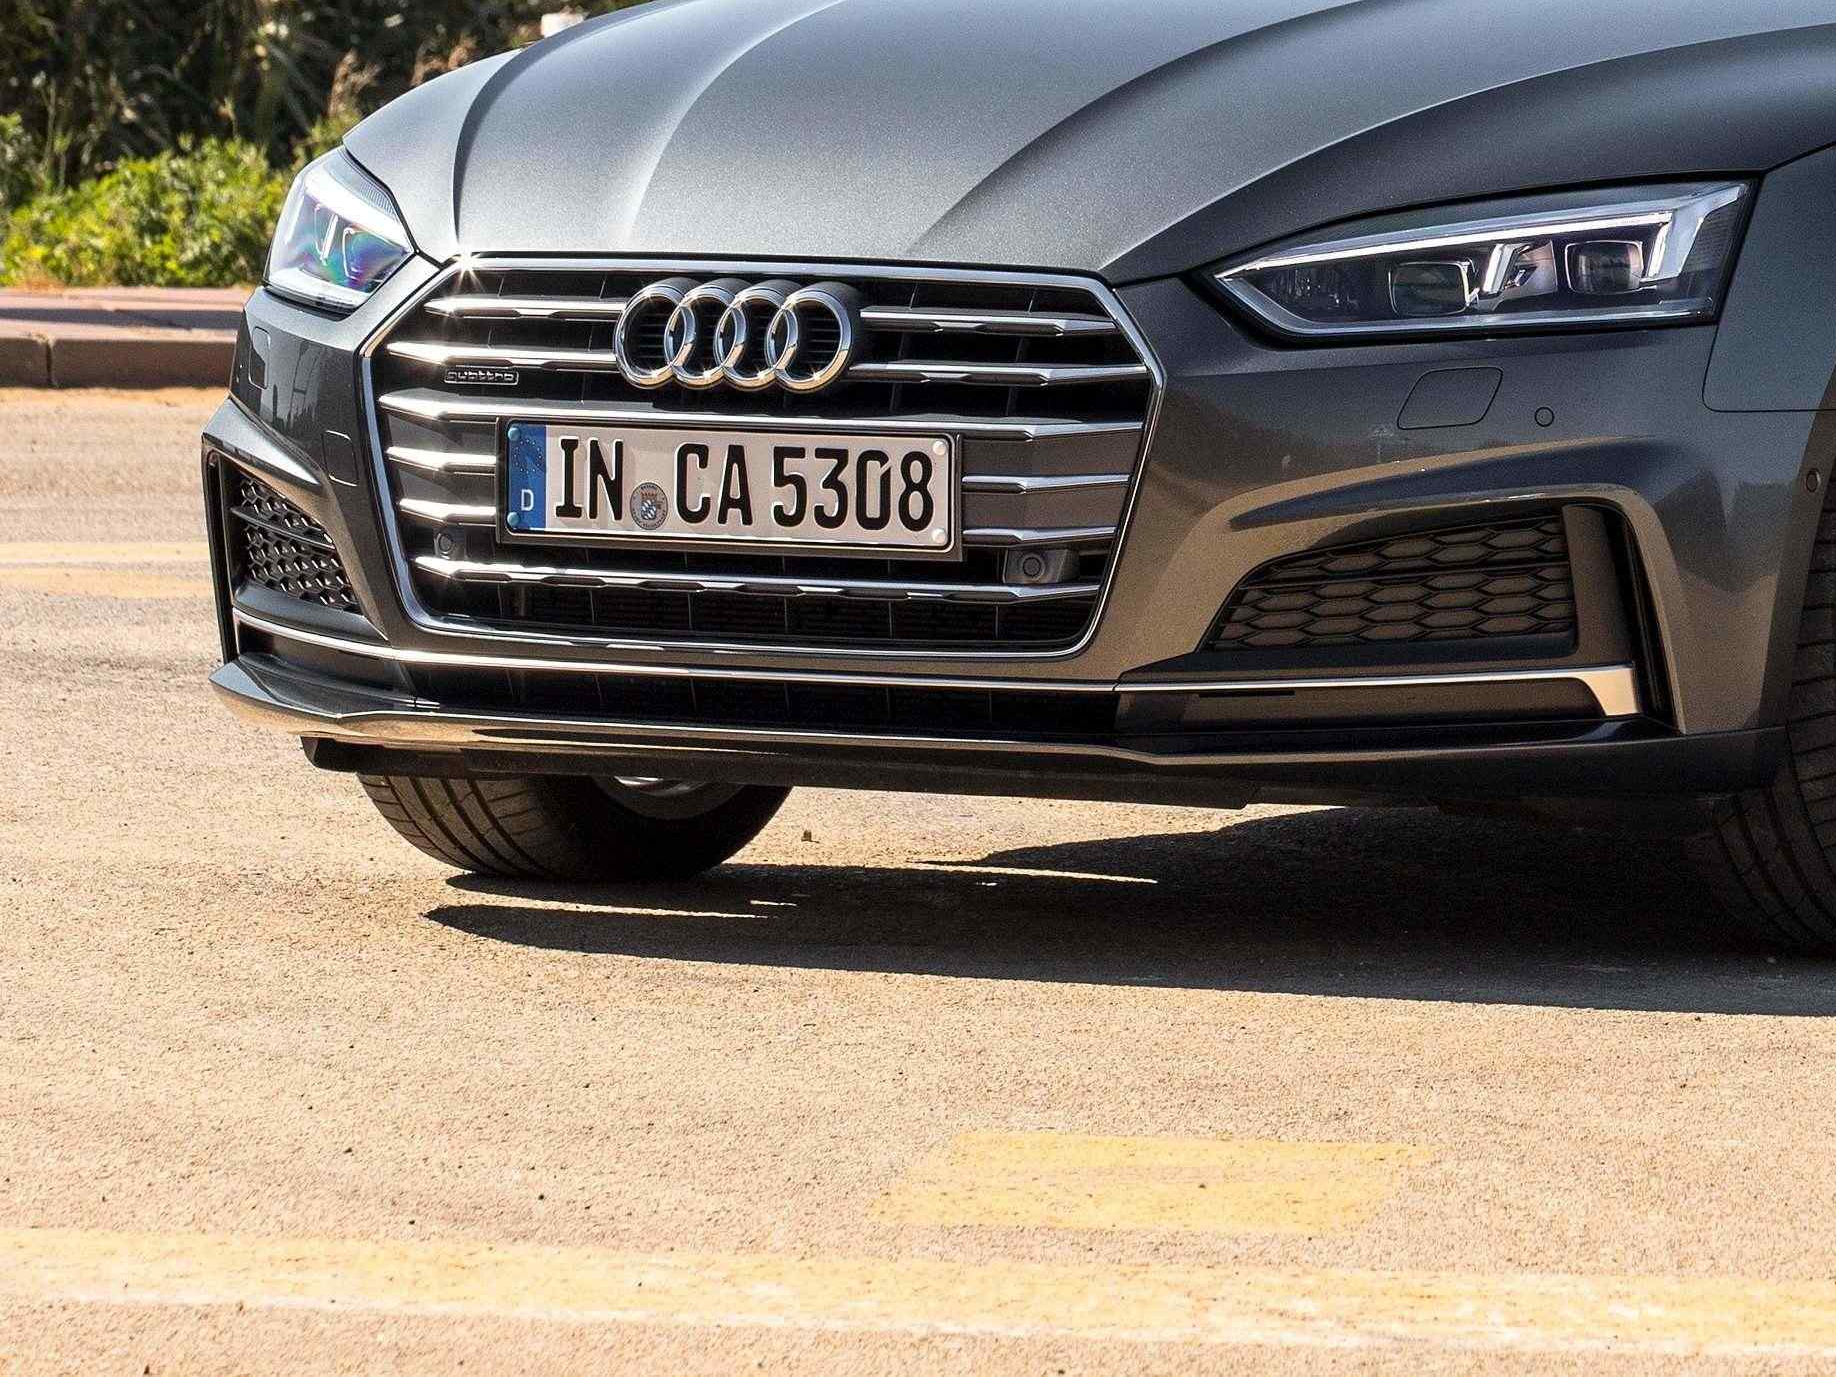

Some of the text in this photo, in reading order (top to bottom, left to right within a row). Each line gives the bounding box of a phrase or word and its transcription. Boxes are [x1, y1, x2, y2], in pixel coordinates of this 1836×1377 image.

[446, 369, 515, 382] quattro
[520, 437, 936, 533] D IN CA 5308
